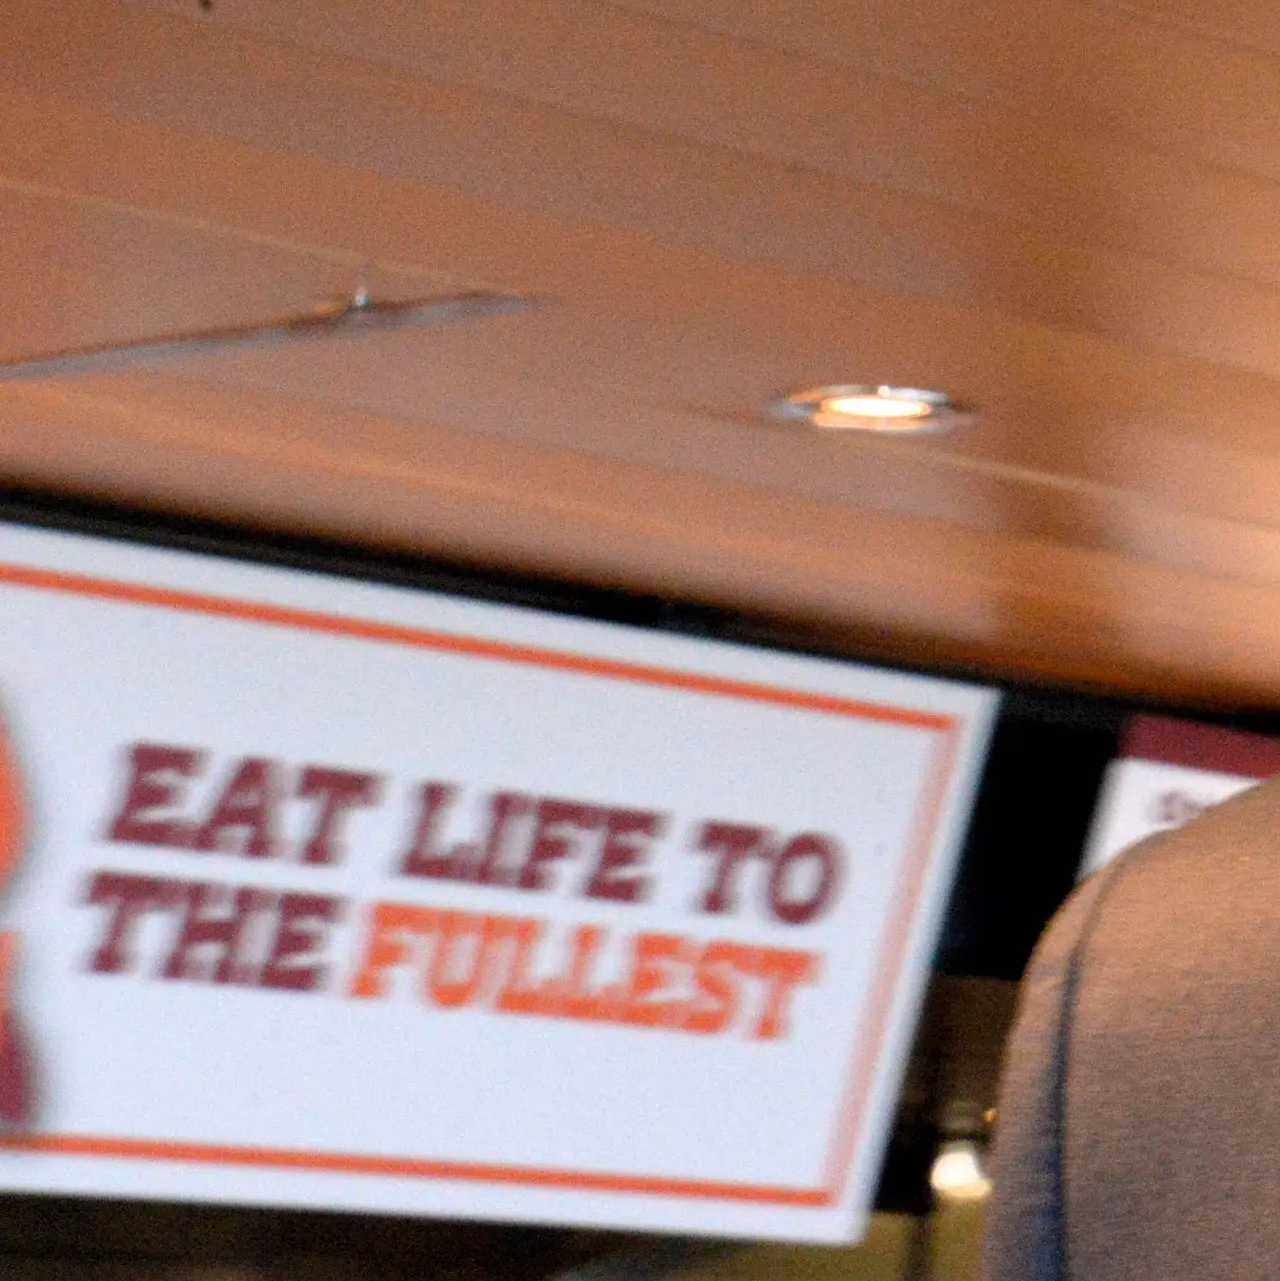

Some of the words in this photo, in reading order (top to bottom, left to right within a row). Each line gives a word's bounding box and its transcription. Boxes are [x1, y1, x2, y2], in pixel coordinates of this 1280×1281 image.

[105, 740, 384, 864] EAT
[396, 781, 669, 903] LIFE
[695, 820, 844, 924] TO
[82, 868, 344, 990] THE
[350, 902, 821, 1040] FULLEST
